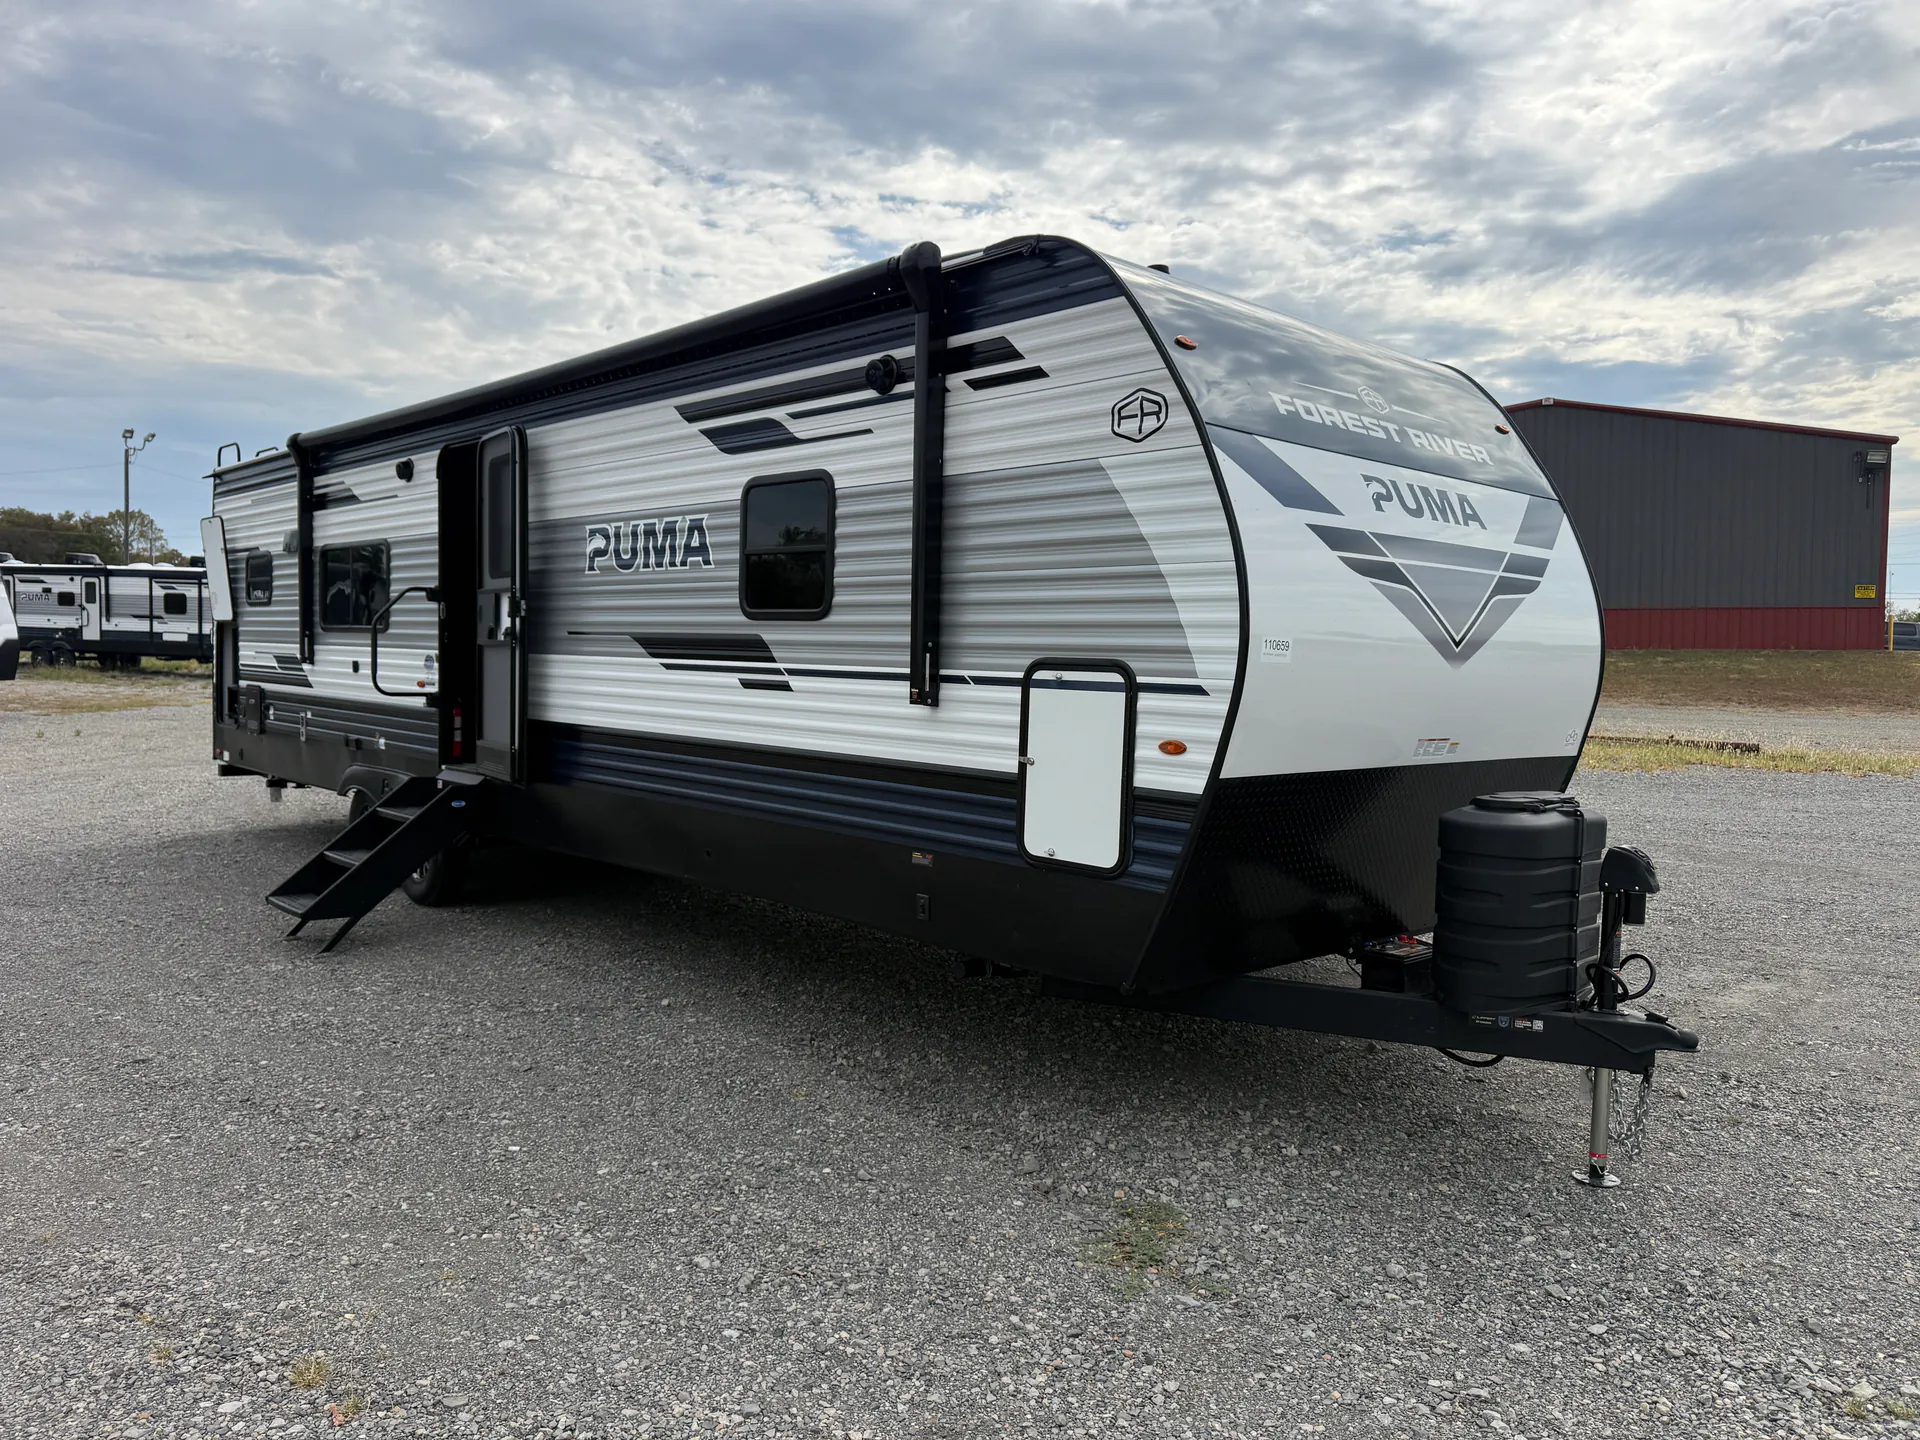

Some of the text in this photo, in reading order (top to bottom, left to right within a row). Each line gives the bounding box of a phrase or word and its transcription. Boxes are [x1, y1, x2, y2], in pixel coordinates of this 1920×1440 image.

[1268, 391, 1494, 466] FOREST RIVER
[1360, 473, 1488, 531] PUMA
[584, 513, 716, 575] PUMA
[20, 593, 50, 601] PUMA
[1264, 638, 1290, 652] 110659
